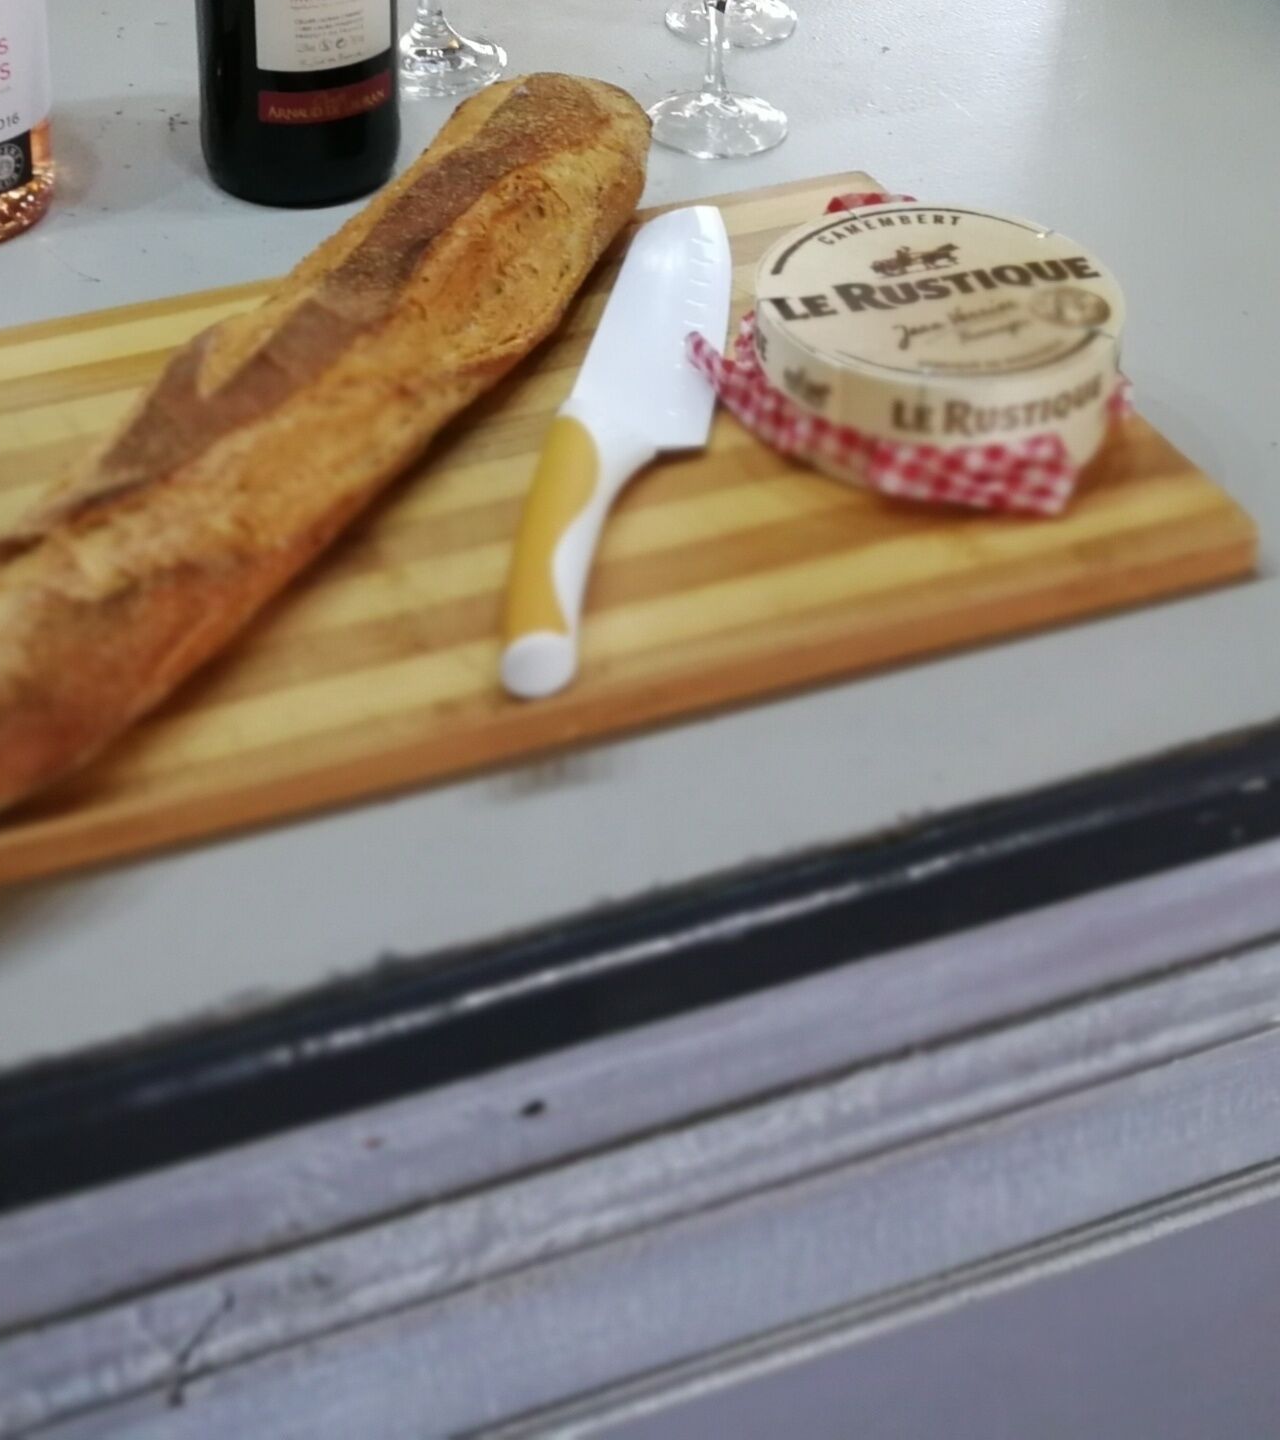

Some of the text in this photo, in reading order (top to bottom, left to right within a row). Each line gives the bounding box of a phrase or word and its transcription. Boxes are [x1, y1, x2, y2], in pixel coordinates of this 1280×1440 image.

[818, 213, 962, 248] CAMEMBERT
[770, 257, 1102, 322] LE RUSTIQUE
[891, 398, 933, 433] LE
